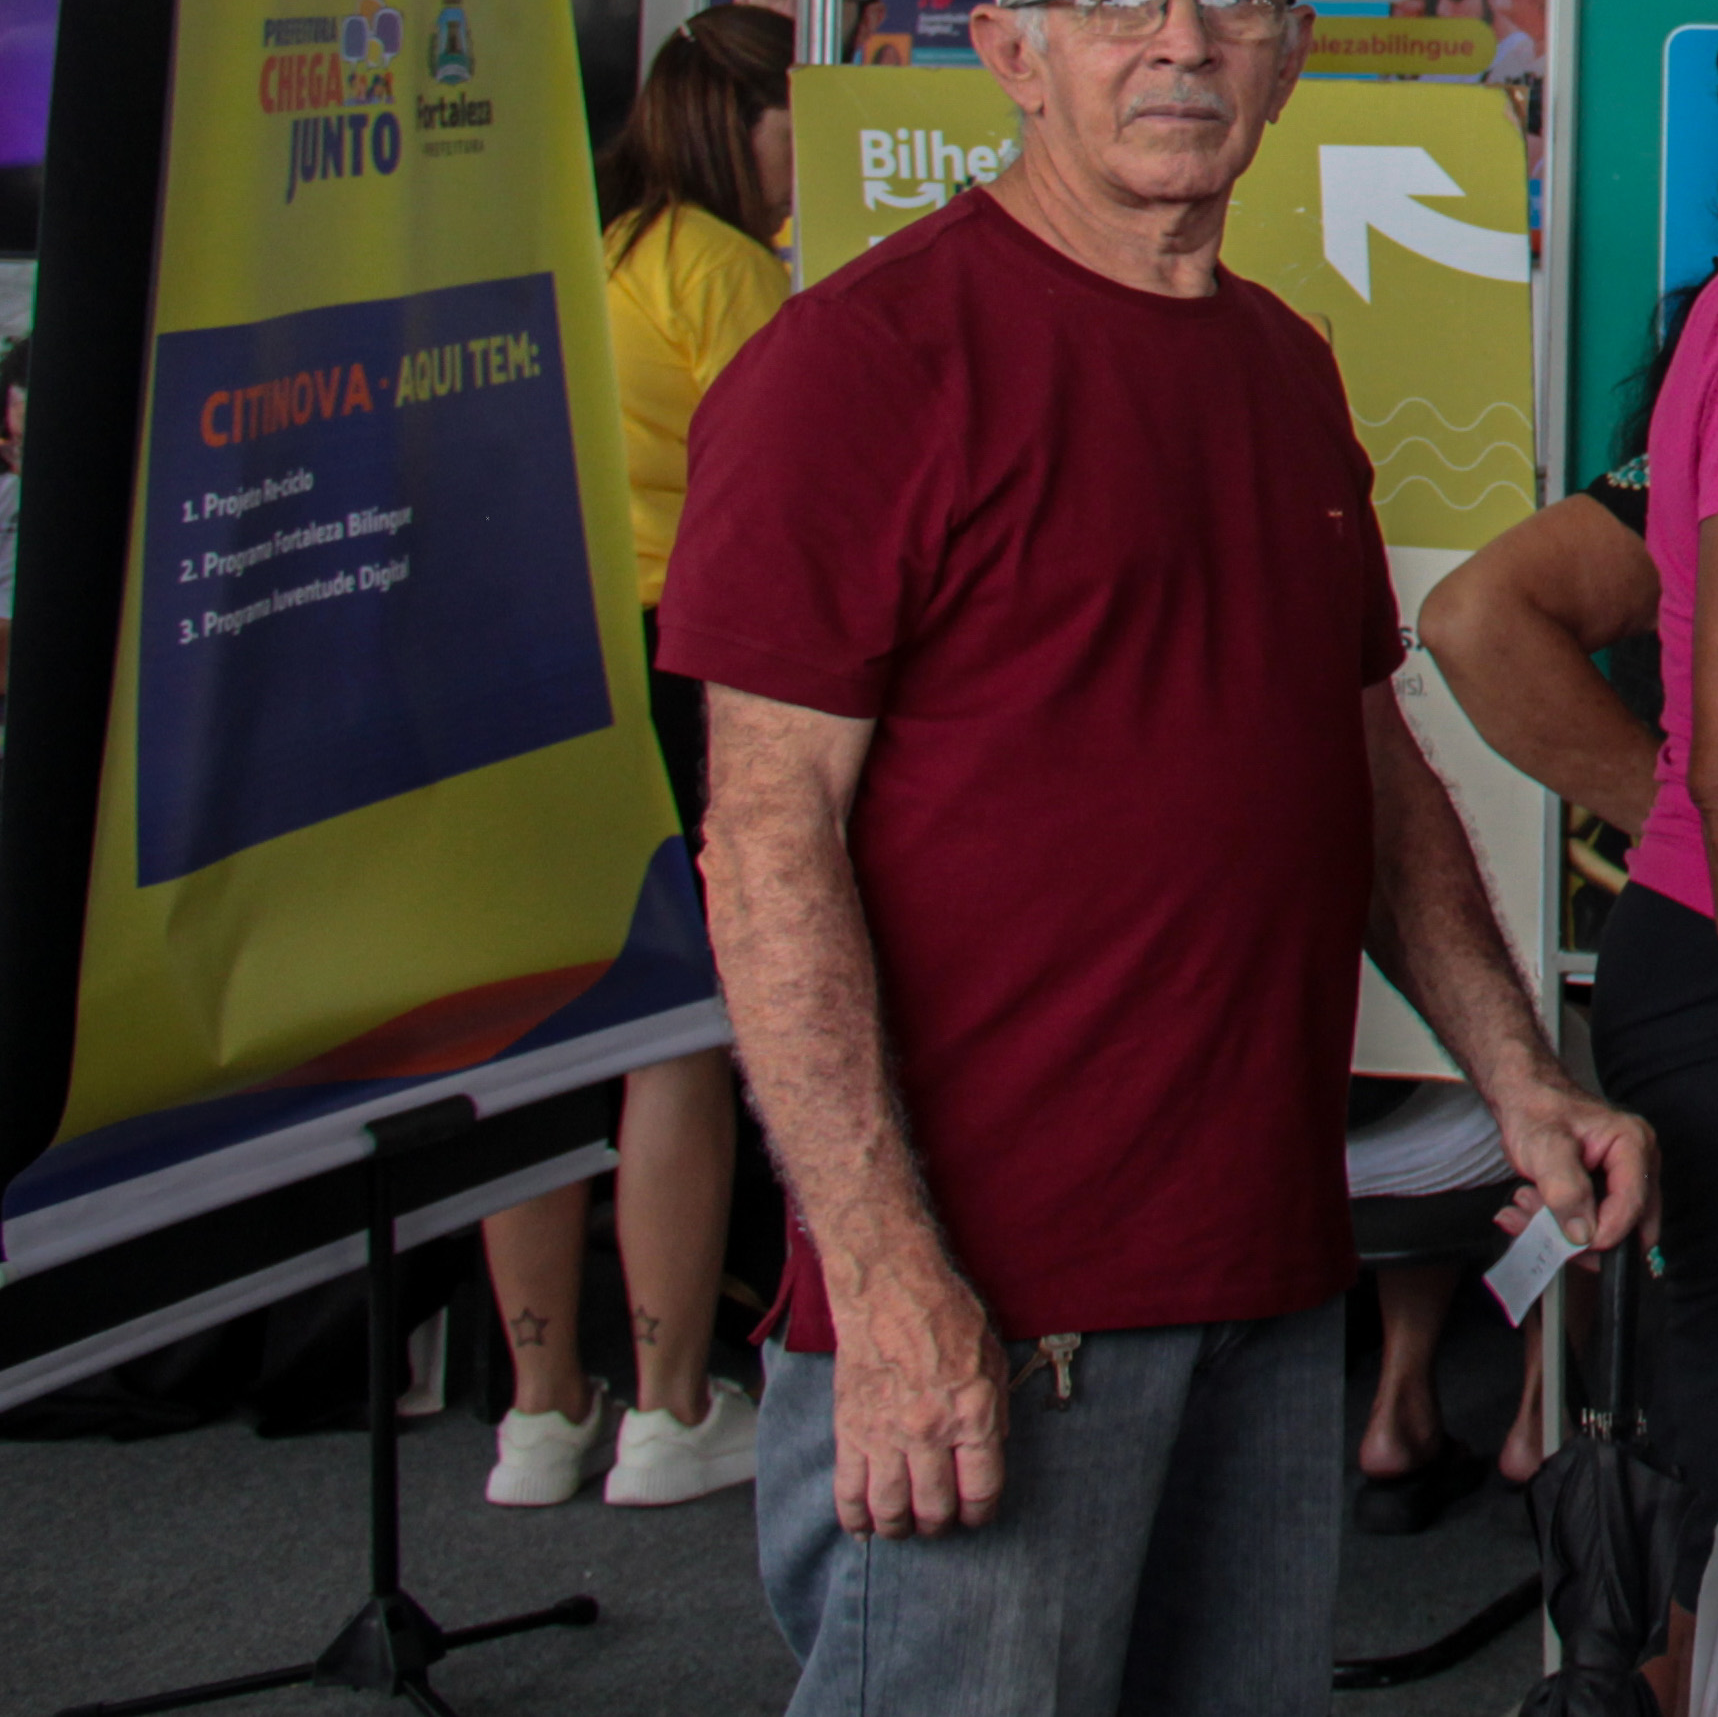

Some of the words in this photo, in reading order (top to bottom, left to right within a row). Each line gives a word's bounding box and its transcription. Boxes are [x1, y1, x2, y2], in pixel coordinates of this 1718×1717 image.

[258, 51, 344, 115] CHEGA
[285, 110, 402, 205] JUNTO
[200, 362, 374, 448] CITINOVA
[395, 342, 463, 408] AQUI
[467, 331, 541, 389] TEM:
[182, 499, 199, 523] 1.
[179, 559, 198, 582] 2.
[274, 520, 344, 556] Fortaleza
[179, 619, 199, 645] 3.
